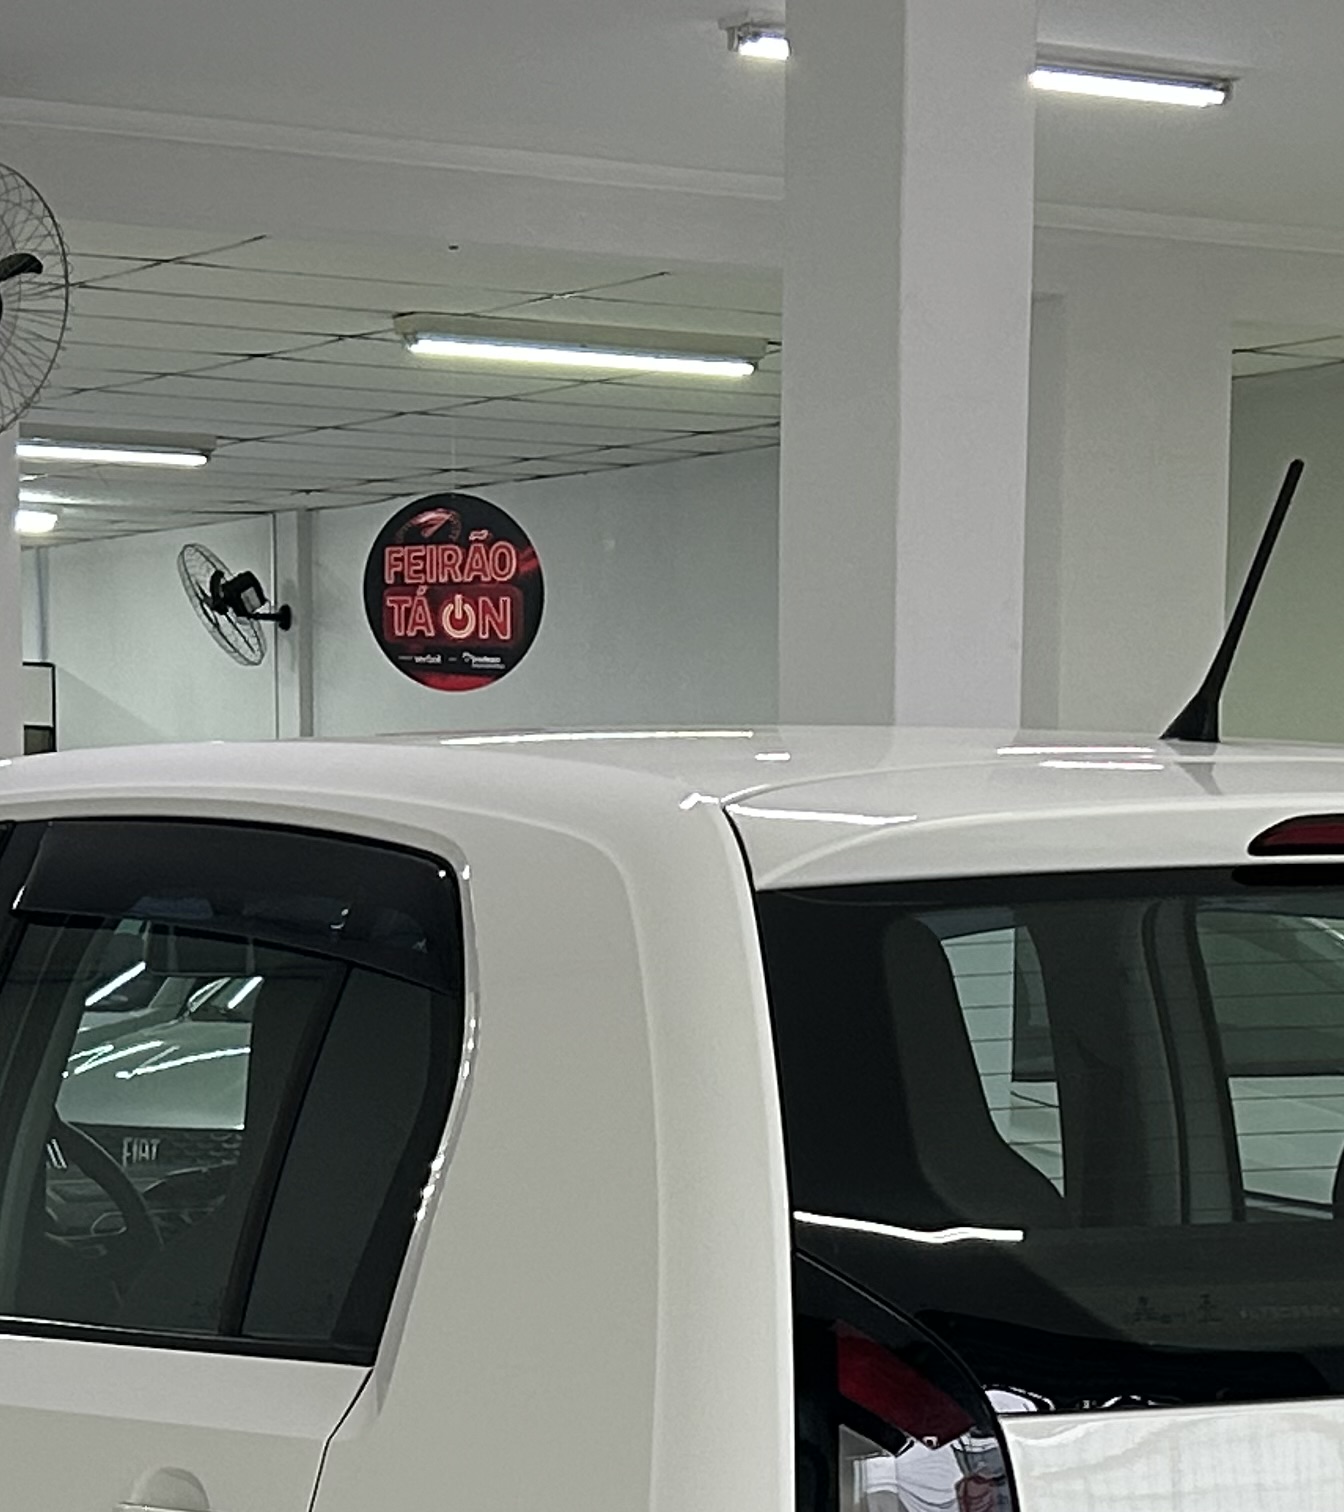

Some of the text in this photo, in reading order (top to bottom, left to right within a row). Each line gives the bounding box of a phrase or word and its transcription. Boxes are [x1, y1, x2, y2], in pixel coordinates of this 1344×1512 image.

[384, 530, 517, 584] FEIRÃO
[386, 585, 435, 637] TÁ
[122, 1136, 161, 1168] FIAT
